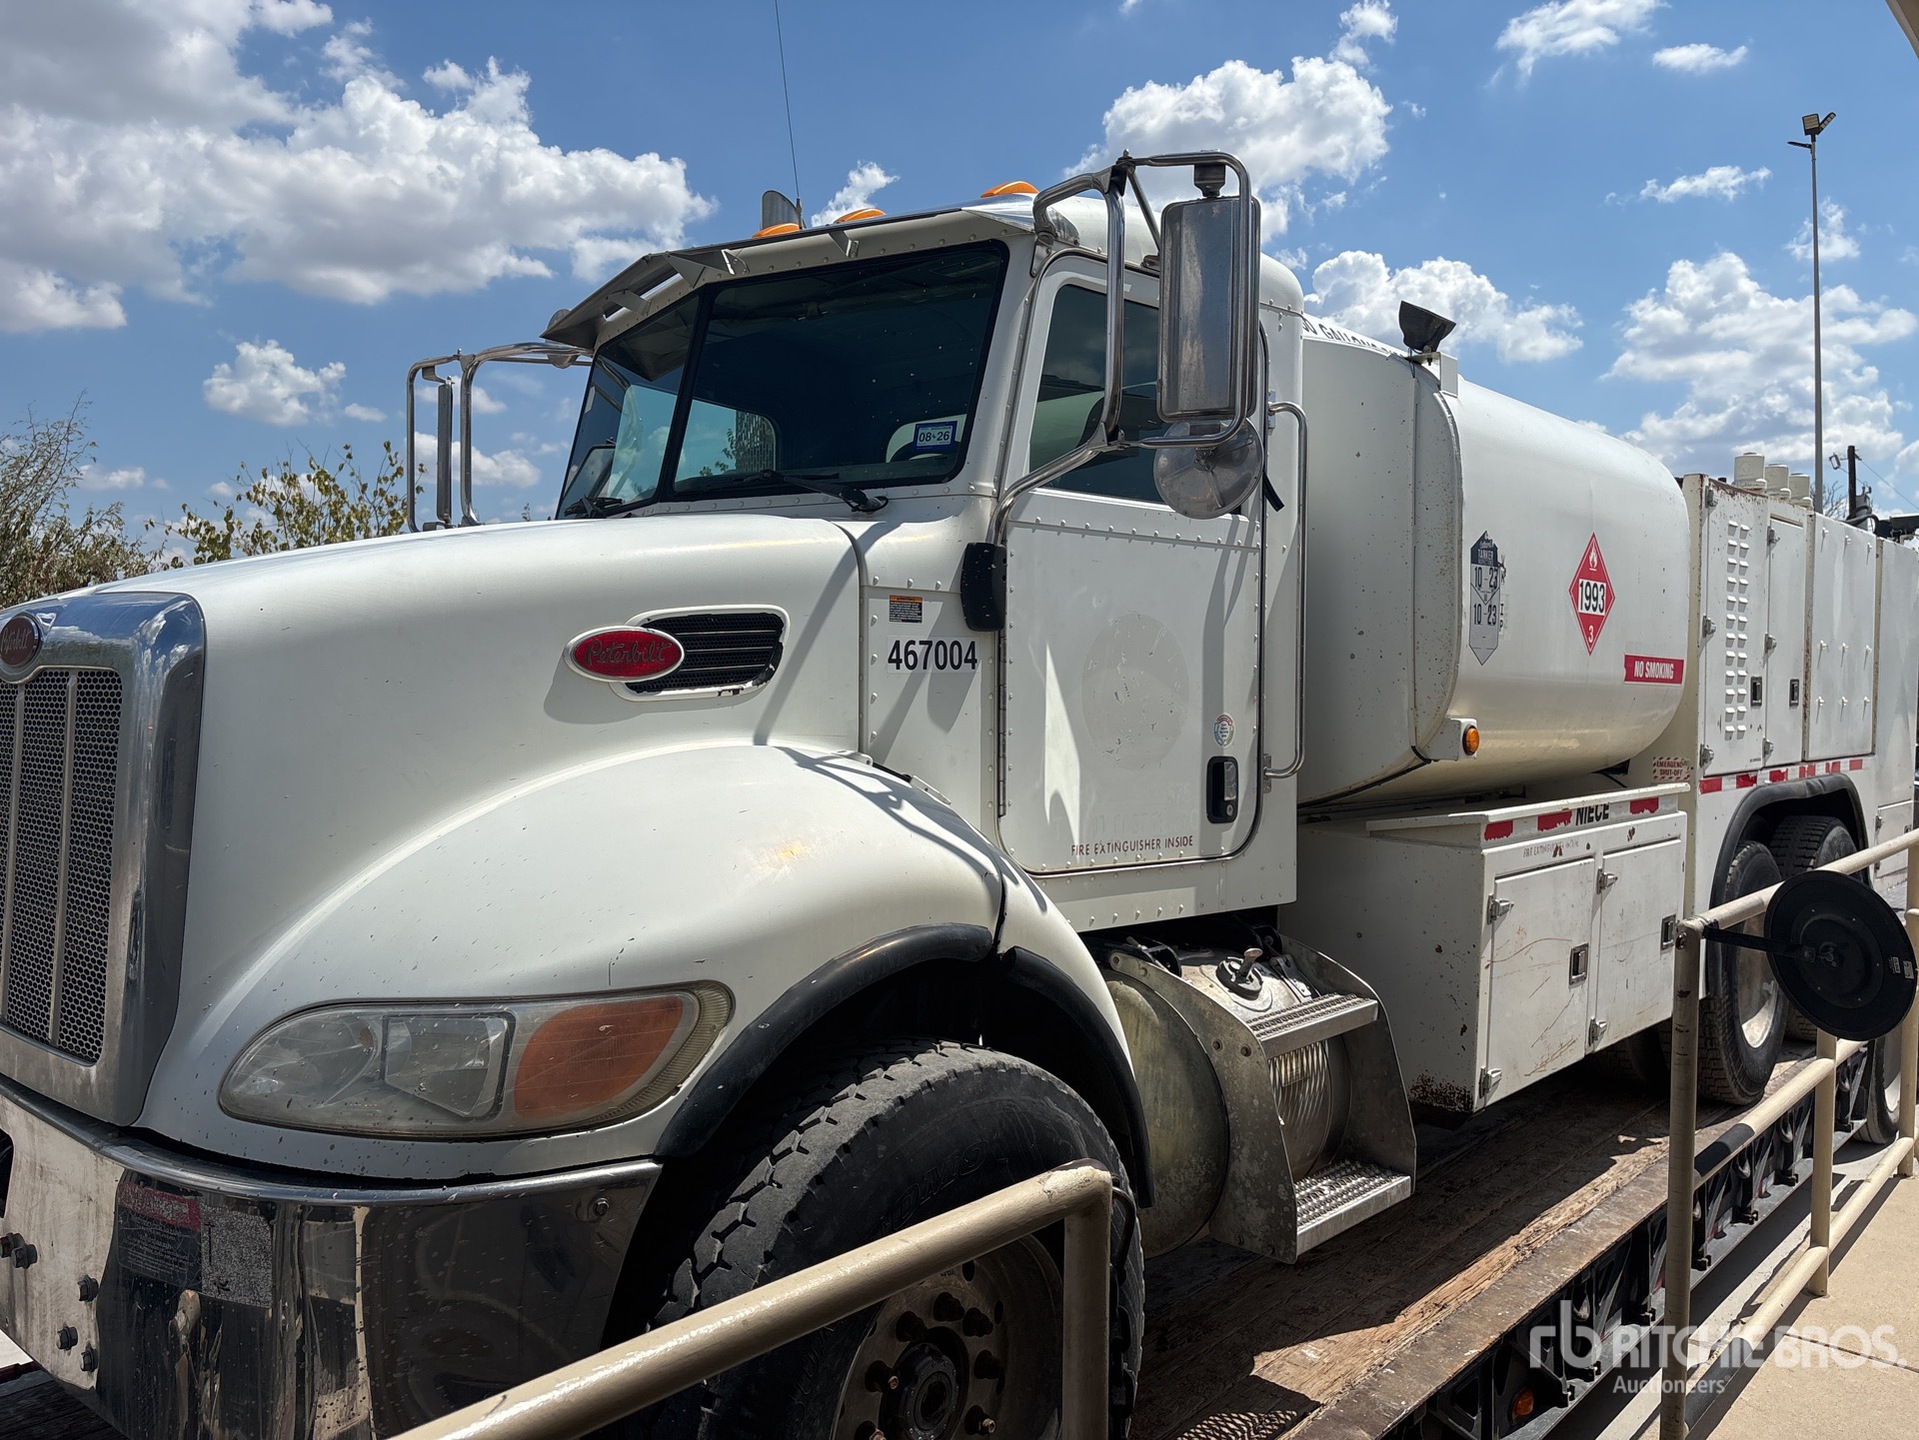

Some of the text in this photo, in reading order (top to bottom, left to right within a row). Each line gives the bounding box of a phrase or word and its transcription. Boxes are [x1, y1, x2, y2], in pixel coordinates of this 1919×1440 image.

[1579, 581, 1605, 613] 1993
[1588, 625, 1594, 643] 3
[586, 639, 672, 666] Peterbilt
[887, 639, 978, 670] 467004
[1634, 660, 1674, 680] NO SMOKING
[1575, 803, 1610, 826] NIECE
[1071, 835, 1193, 856] FIRE EXTINGUISHER INSIDE
